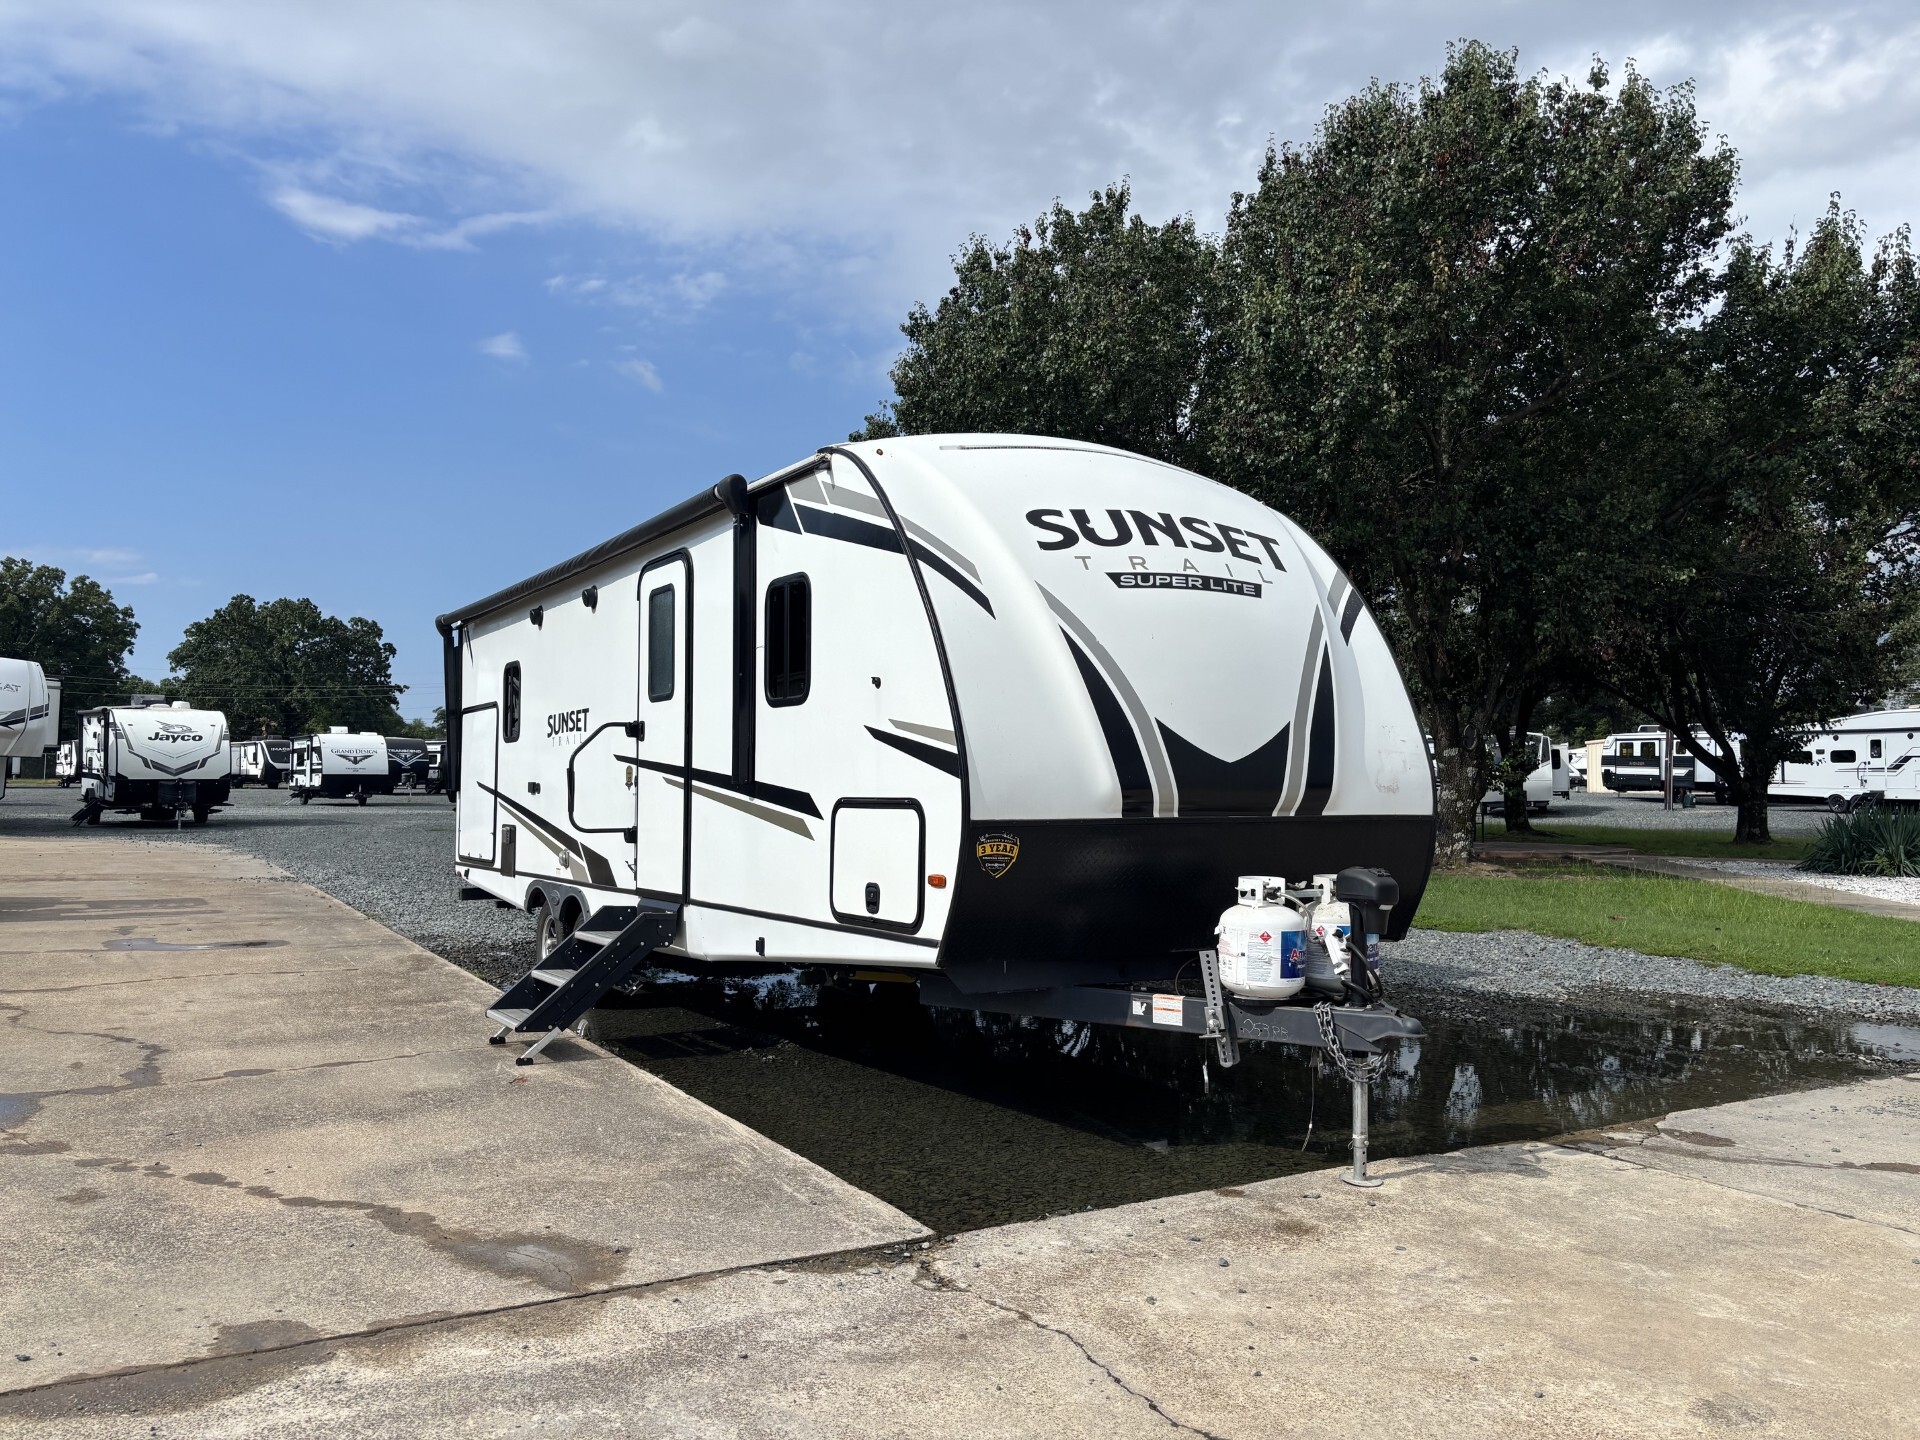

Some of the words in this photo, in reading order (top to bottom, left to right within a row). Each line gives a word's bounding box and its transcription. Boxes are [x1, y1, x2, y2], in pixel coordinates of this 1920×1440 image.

[1025, 508, 1288, 573] SUNSET
[1074, 555, 1274, 585] TRAIL
[1119, 575, 1203, 588] SUPER
[1209, 579, 1256, 595] LITE
[547, 708, 589, 738] SUNSET
[148, 732, 203, 743] Jayco
[552, 733, 583, 747] TRAIL
[981, 846, 986, 854] 3
[989, 844, 1015, 855] YEAR
